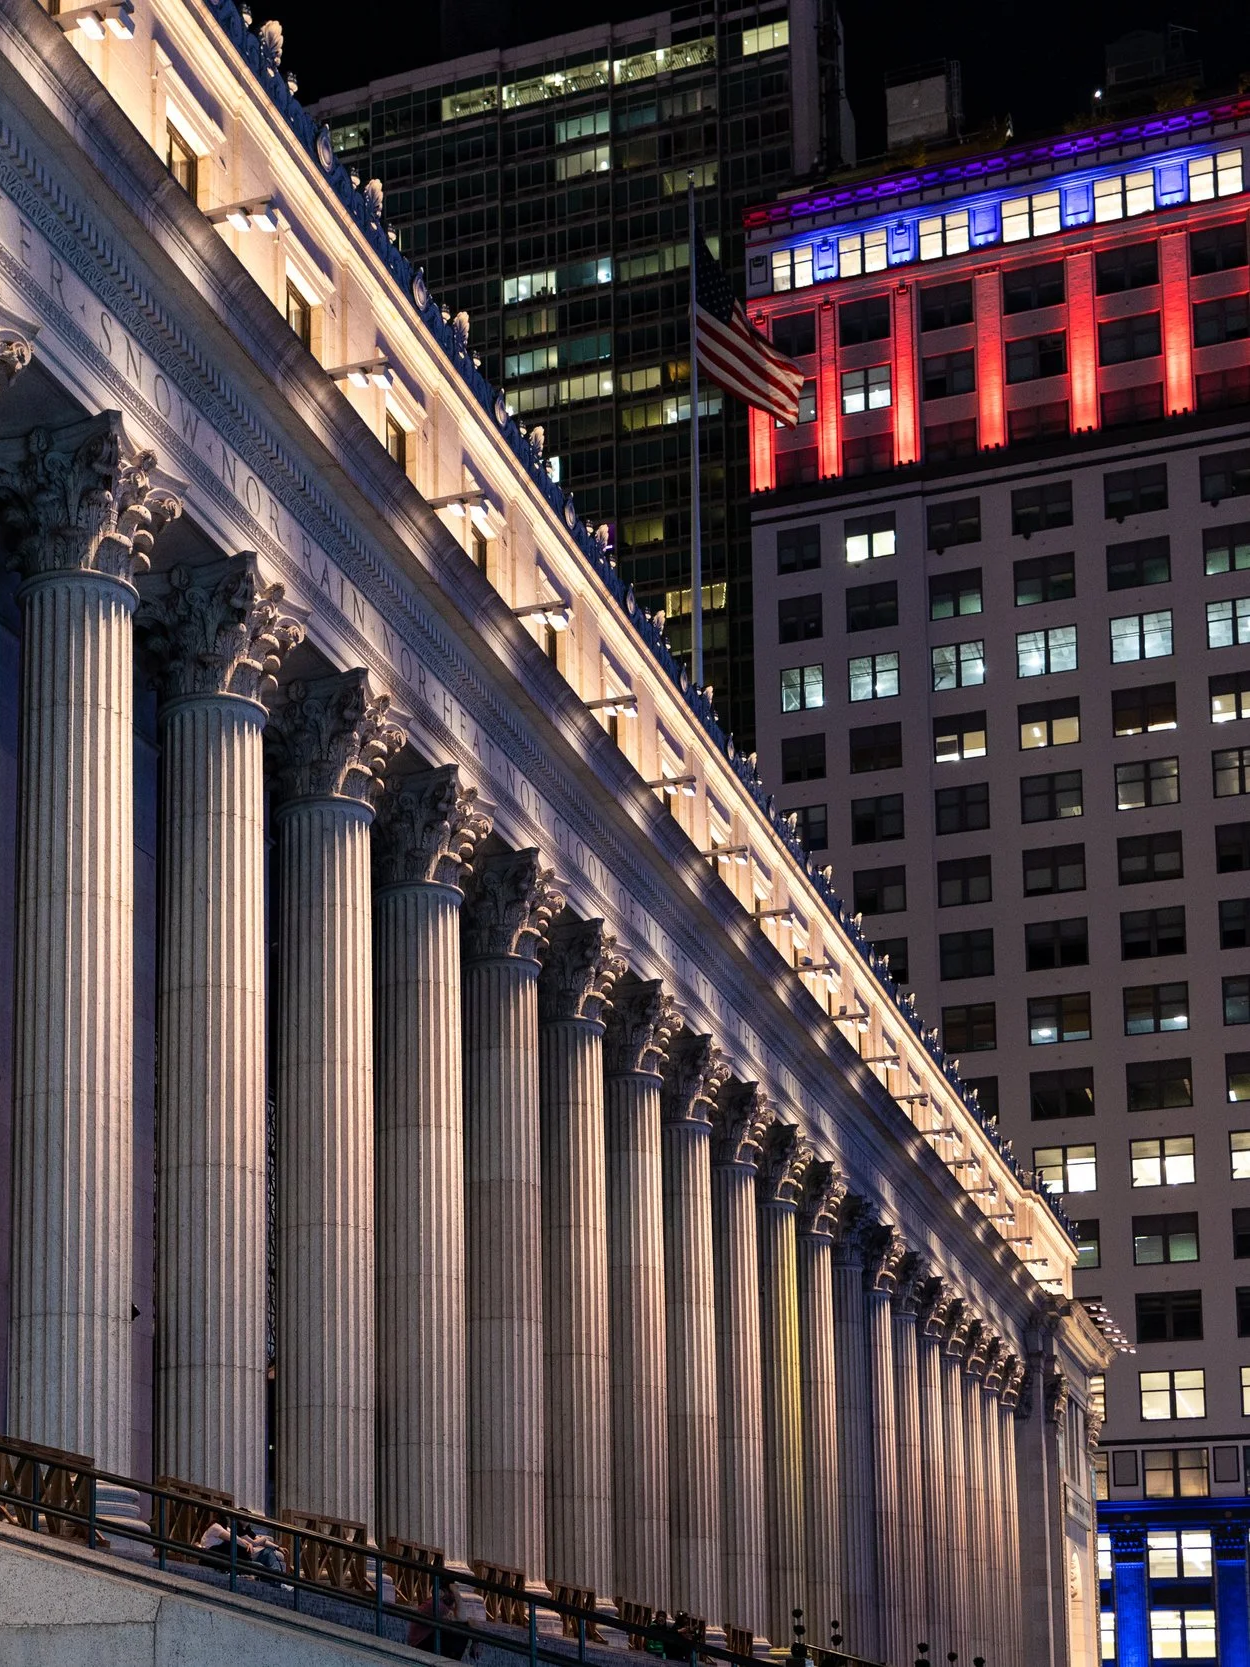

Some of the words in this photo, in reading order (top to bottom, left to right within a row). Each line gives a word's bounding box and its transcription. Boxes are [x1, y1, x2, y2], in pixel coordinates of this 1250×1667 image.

[100, 311, 201, 446] SNOW
[221, 444, 286, 547] NOR
[302, 535, 366, 632] RAIN
[382, 622, 432, 704] NOR
[443, 690, 495, 772] HEAT
[506, 762, 544, 828] NOR
[554, 816, 610, 897] GLOOM
[618, 888, 635, 923] OF
[643, 915, 687, 980] NIGHT
[695, 973, 731, 1028] STAYS
